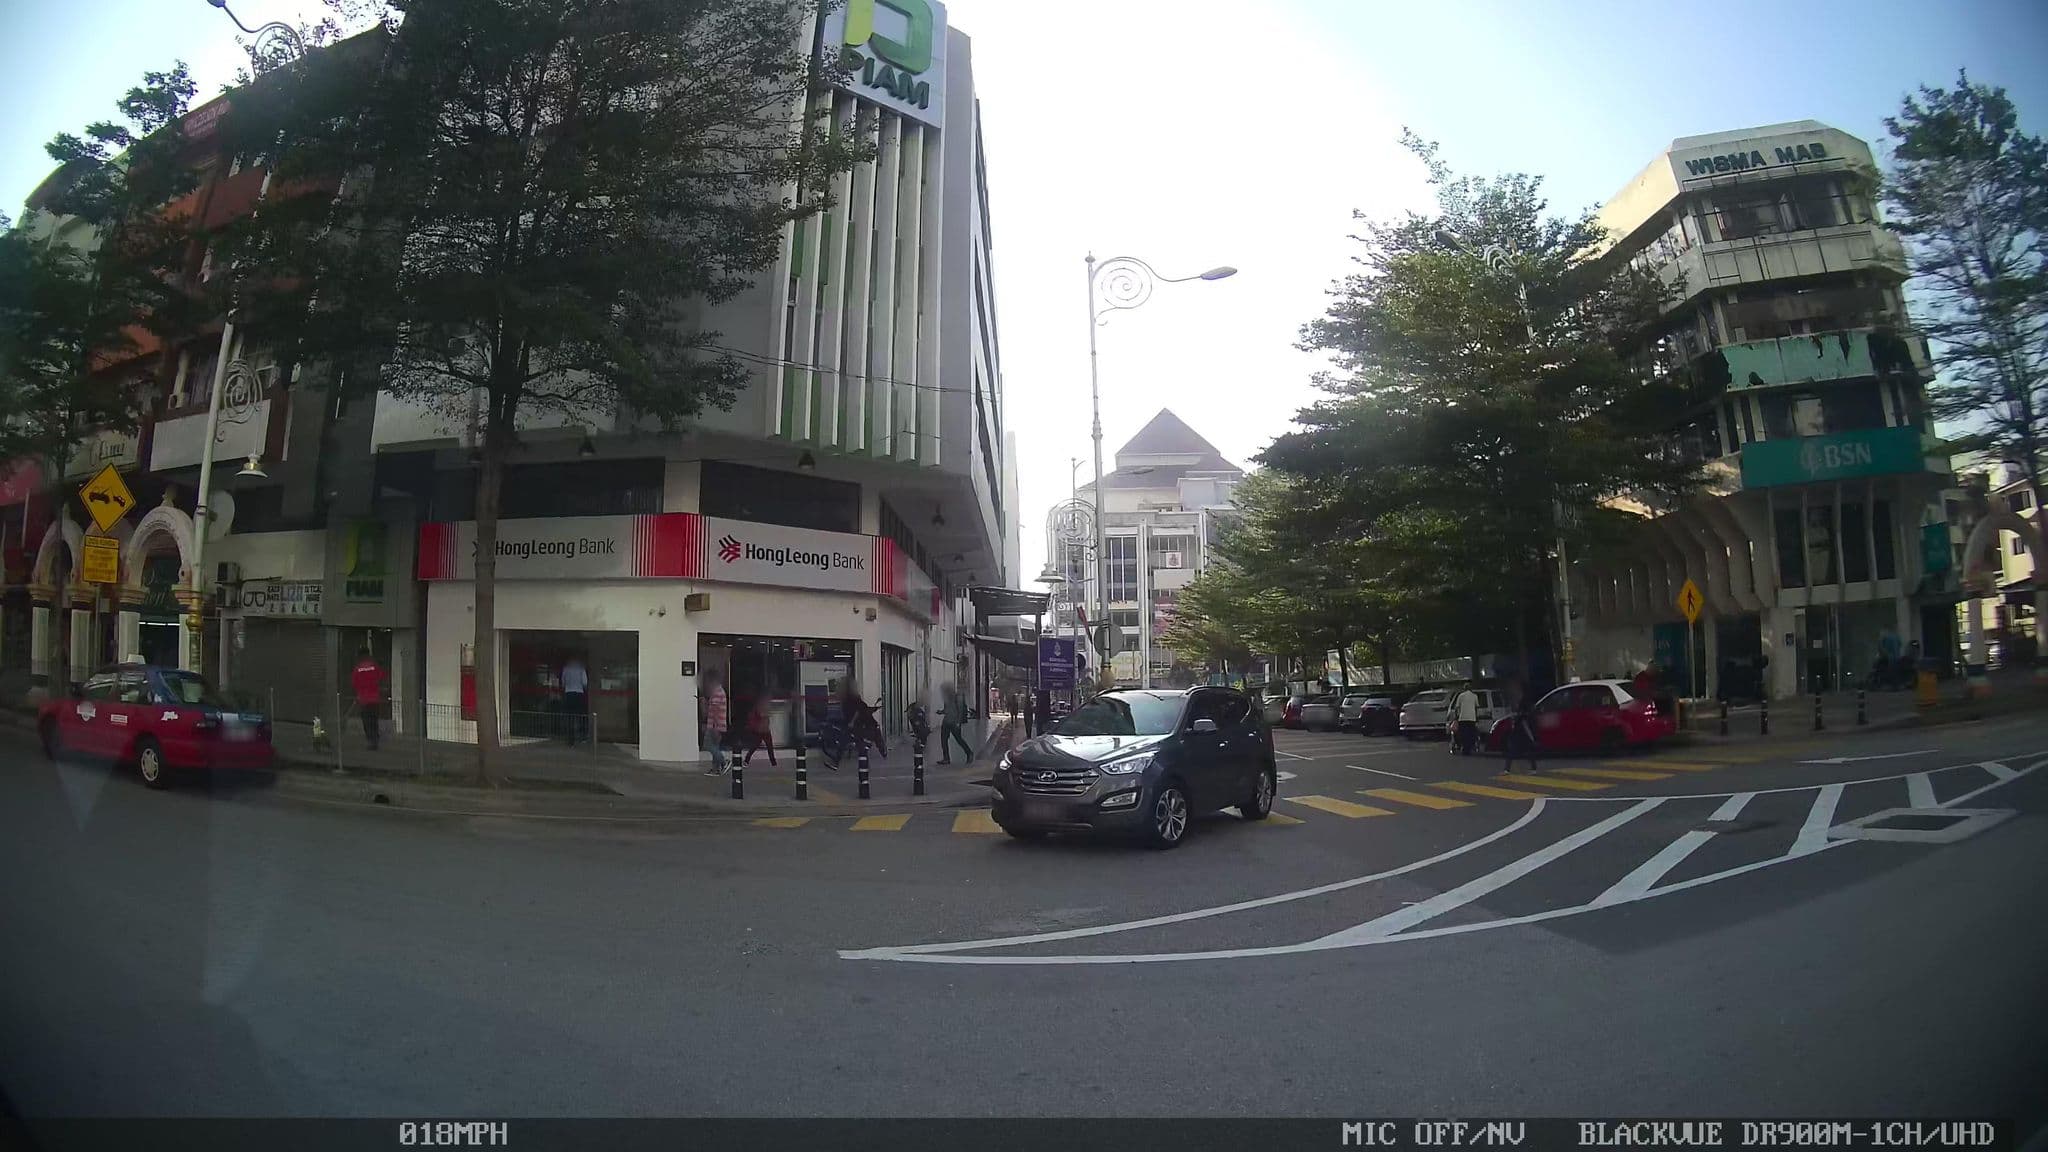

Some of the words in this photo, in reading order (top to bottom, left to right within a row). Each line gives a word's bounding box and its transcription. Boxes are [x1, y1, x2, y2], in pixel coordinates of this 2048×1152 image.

[839, 48, 930, 110] PIAM
[1685, 150, 1767, 175] WISMA
[1824, 442, 1872, 468] BSN
[495, 539, 575, 559] HongLeong
[579, 538, 615, 555] Bank
[745, 543, 829, 570] HongLeong
[832, 552, 865, 570] Bank
